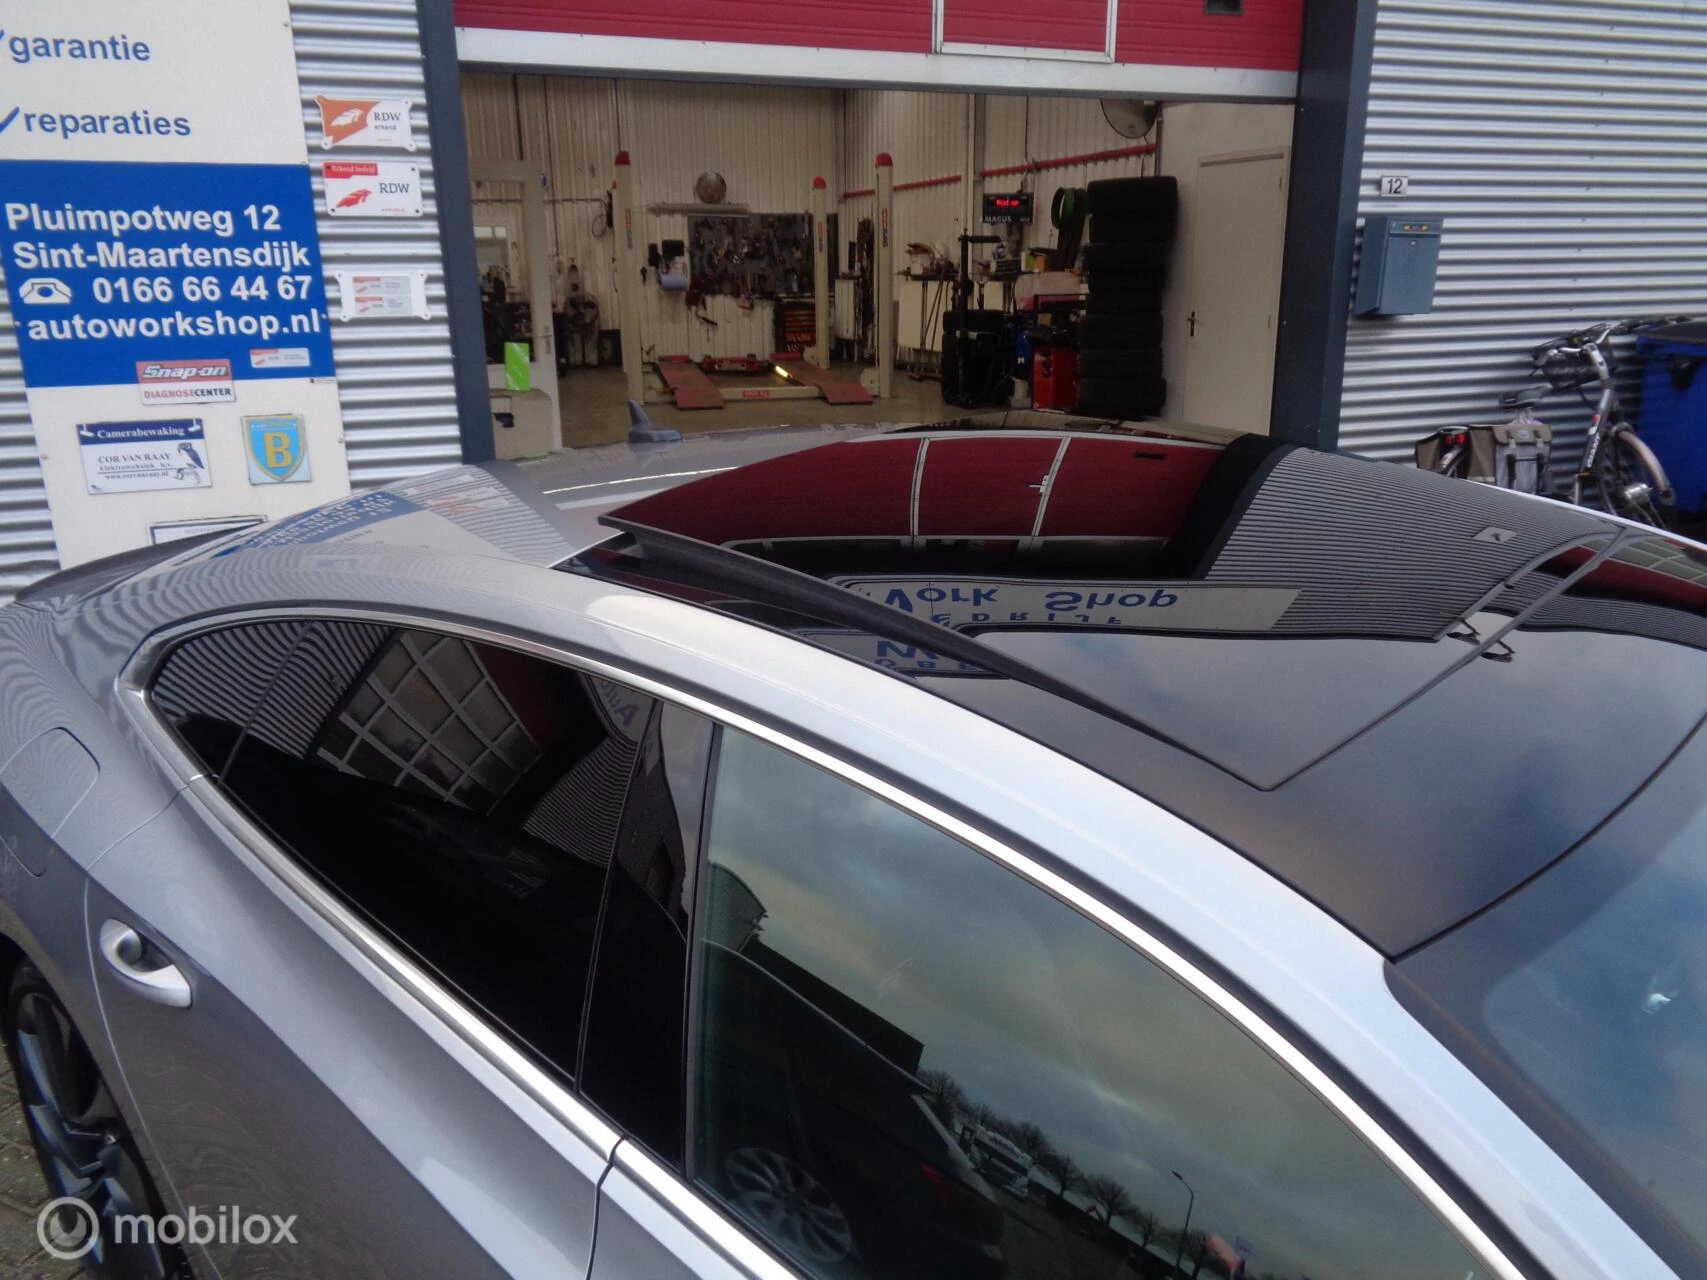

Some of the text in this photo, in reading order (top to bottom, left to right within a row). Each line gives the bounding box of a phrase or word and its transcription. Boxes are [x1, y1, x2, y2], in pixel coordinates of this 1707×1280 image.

[9, 34, 151, 64] garantie
[24, 110, 192, 139] reparaties
[374, 112, 400, 121] RDW
[379, 183, 409, 193] RDW
[1387, 178, 1403, 194] 12
[5, 203, 281, 237] Pluimpotweg 12
[13, 241, 311, 272] Sint-Maartensdijk
[92, 274, 312, 303] 0166 66 44 67
[28, 308, 320, 340] autoworkshop.nl
[143, 365, 228, 380] Snap-on
[97, 426, 185, 439] Camerabewaking
[264, 432, 292, 468] B
